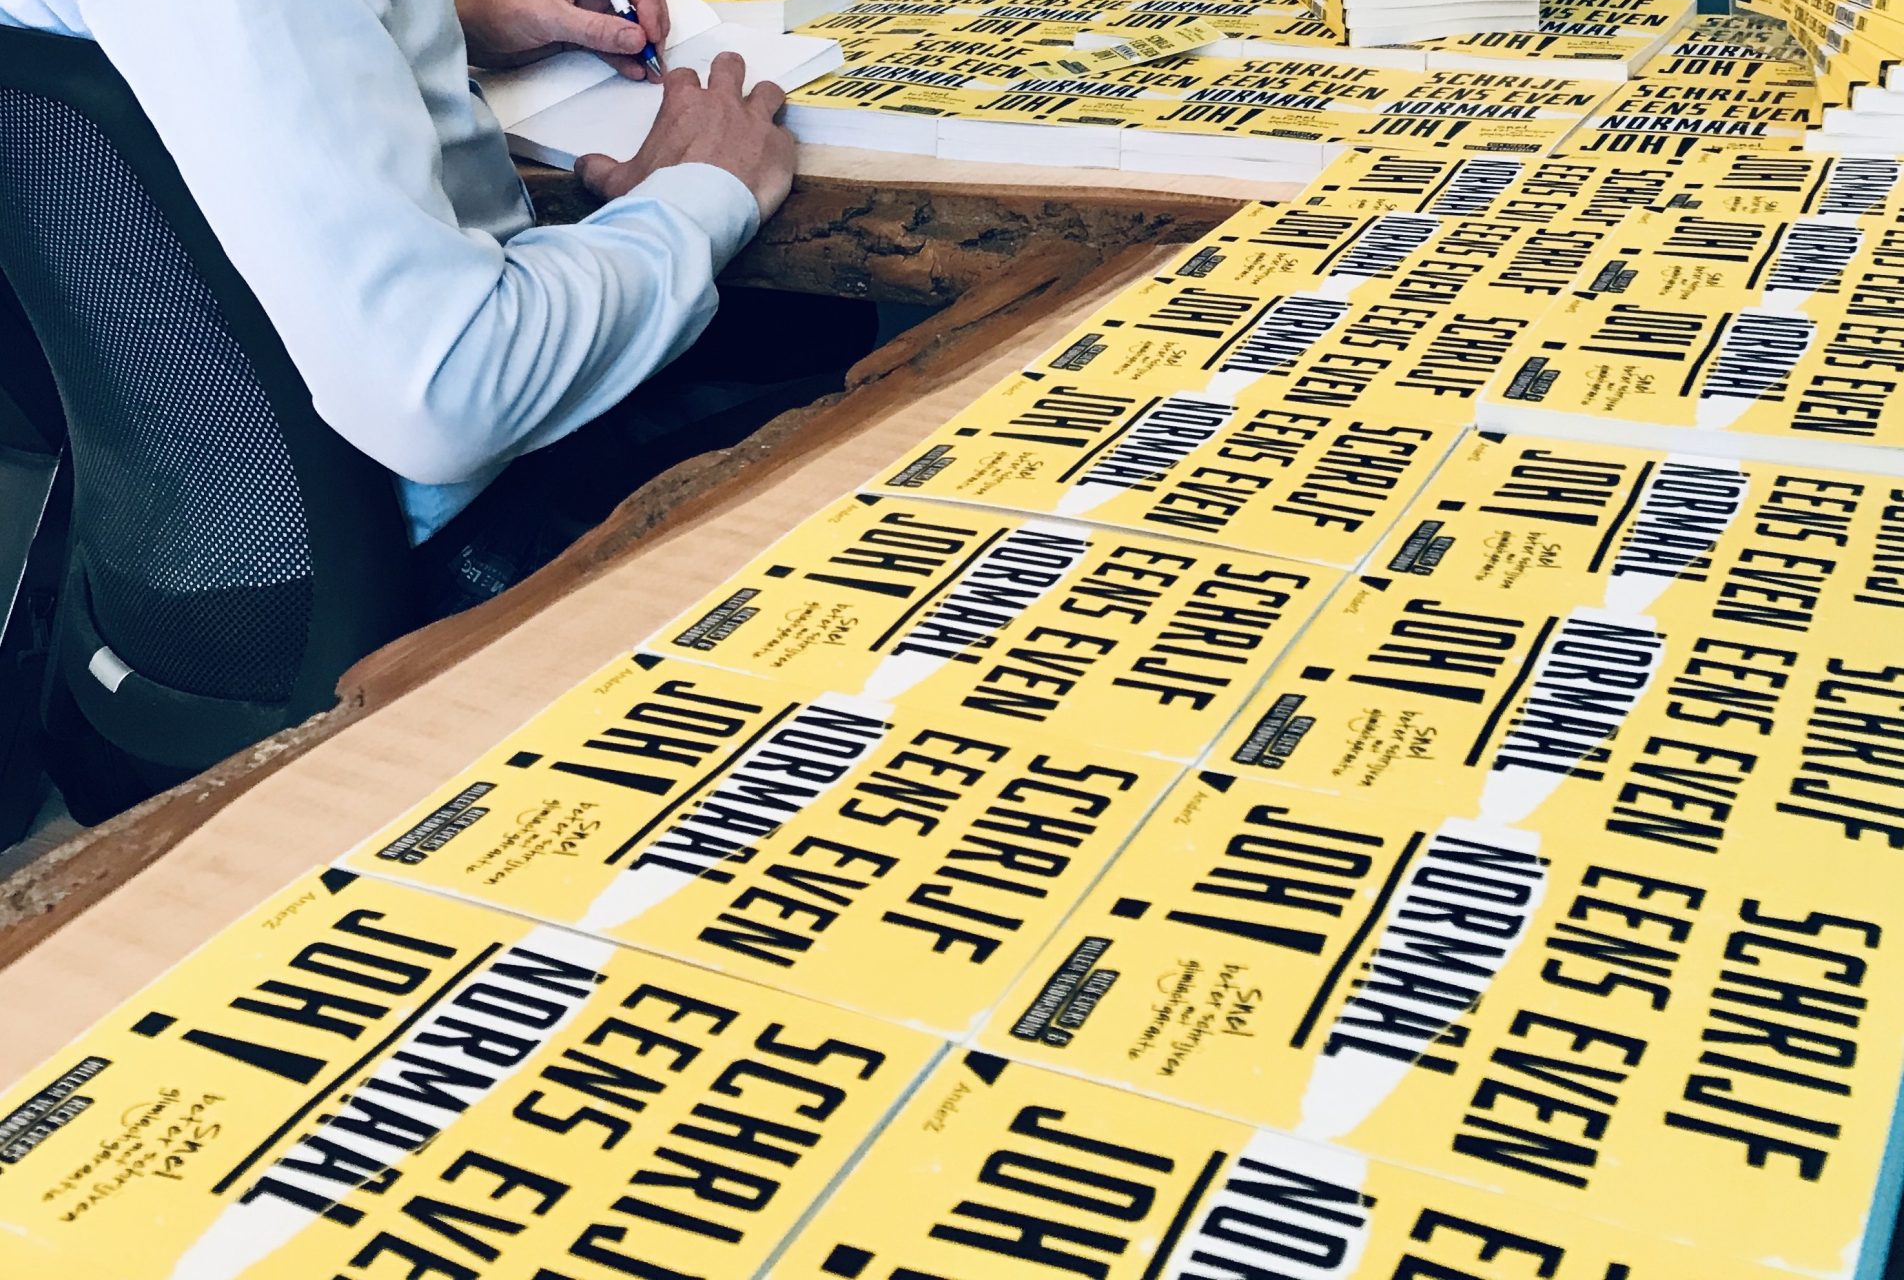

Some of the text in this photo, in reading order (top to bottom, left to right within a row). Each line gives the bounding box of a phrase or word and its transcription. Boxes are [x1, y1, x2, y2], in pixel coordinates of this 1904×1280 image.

[808, 16, 897, 34] JOH!
[840, 3, 958, 14] NORMAAL
[952, 18, 1042, 42] JOH!
[982, 6, 1103, 21] NORMAAL
[1134, 0, 1262, 15] NORMAAL
[1584, 10, 1670, 26] EVEN
[874, 52, 955, 67] EENS
[949, 58, 1028, 79] EVEN
[903, 39, 1034, 61] SCHRIJF
[1233, 60, 1380, 82] SCHRIJF
[1457, 32, 1560, 56] JOH!
[1658, 58, 1764, 84] JOH!
[805, 80, 907, 107] JOH!
[845, 65, 977, 88] NORMAAL
[1008, 78, 1150, 98] NORMAAL
[1118, 70, 1204, 88] EVEN
[1186, 88, 1335, 111] NORMAAL
[1210, 74, 1390, 100] EENS EVEN
[1404, 86, 1596, 106] EENS EVEN
[1424, 71, 1580, 91] SCHRIJF
[1631, 84, 1798, 104] SCHRIJF
[974, 94, 1079, 120] JOH!
[1156, 104, 1265, 132] JOH!
[1358, 118, 1472, 148] JOH!
[1384, 100, 1542, 119] NORMAAL
[1600, 115, 1768, 136] NORMAAL
[1614, 99, 1712, 116] EENS
[1321, 155, 1447, 194] JOH!
[1580, 132, 1700, 166] JOH!
[1684, 154, 1815, 192] JOH!
[1428, 158, 1526, 218] NORMAAL
[1520, 164, 1598, 198] EENS
[1572, 168, 1674, 226] SCHRIJF
[1817, 157, 1904, 216] NORMAAL
[1218, 208, 1358, 251] JOH!
[1328, 214, 1444, 278] NORMAAL
[1434, 221, 1522, 258] EENS
[1619, 215, 1766, 262] JOH!
[1765, 222, 1865, 294] NORMAAL
[1389, 259, 1485, 305] EVEN
[1488, 228, 1604, 296] SCHRIJF
[1102, 286, 1260, 340] JOH!
[1218, 296, 1354, 378] NORMAAL
[1542, 304, 1707, 362] JOH!
[1282, 304, 1438, 408] EENS EVEN
[1394, 314, 1529, 398] SCHRIJF
[1700, 313, 1818, 402] NORMAAL
[954, 384, 1136, 448] JOH!
[1791, 375, 1897, 437] EVEN
[1072, 397, 1240, 492] NORMAAL
[1143, 408, 1333, 534] EENS EVEN
[1272, 421, 1434, 533] SCHRIJF
[1437, 448, 1627, 527] JOH!
[1612, 462, 1751, 582] NORMAAL
[764, 511, 978, 600] JOH!
[1712, 475, 1865, 632] EENS EVEN
[890, 529, 1094, 665] NORMAAL
[960, 545, 1198, 723] EENS EVEN
[1111, 563, 1311, 712] SCHRIJF
[1300, 598, 1526, 706] JOH!
[1494, 618, 1668, 782] NORMAAL
[505, 678, 764, 797] JOH!
[1605, 637, 1799, 854] EENS EVEN
[1776, 658, 1904, 850] SCHRIJF
[629, 704, 895, 885] NORMAAL
[696, 728, 1012, 968] EENS EVEN
[882, 754, 1140, 965] SCHRIJF
[1109, 804, 1384, 955] JOH!
[1323, 833, 1551, 1076] NORMAAL
[130, 906, 458, 1086] JOH!
[1451, 864, 1707, 1191] EENS EVEN
[1664, 897, 1884, 1184] SCHRIJF
[238, 945, 608, 1228] NORMAAL
[152, 1123, 221, 1181] Snel
[331, 983, 742, 1280] EENS EVE
[534, 1023, 887, 1280] SCHRIJ
[820, 1104, 1177, 1280] JOH
